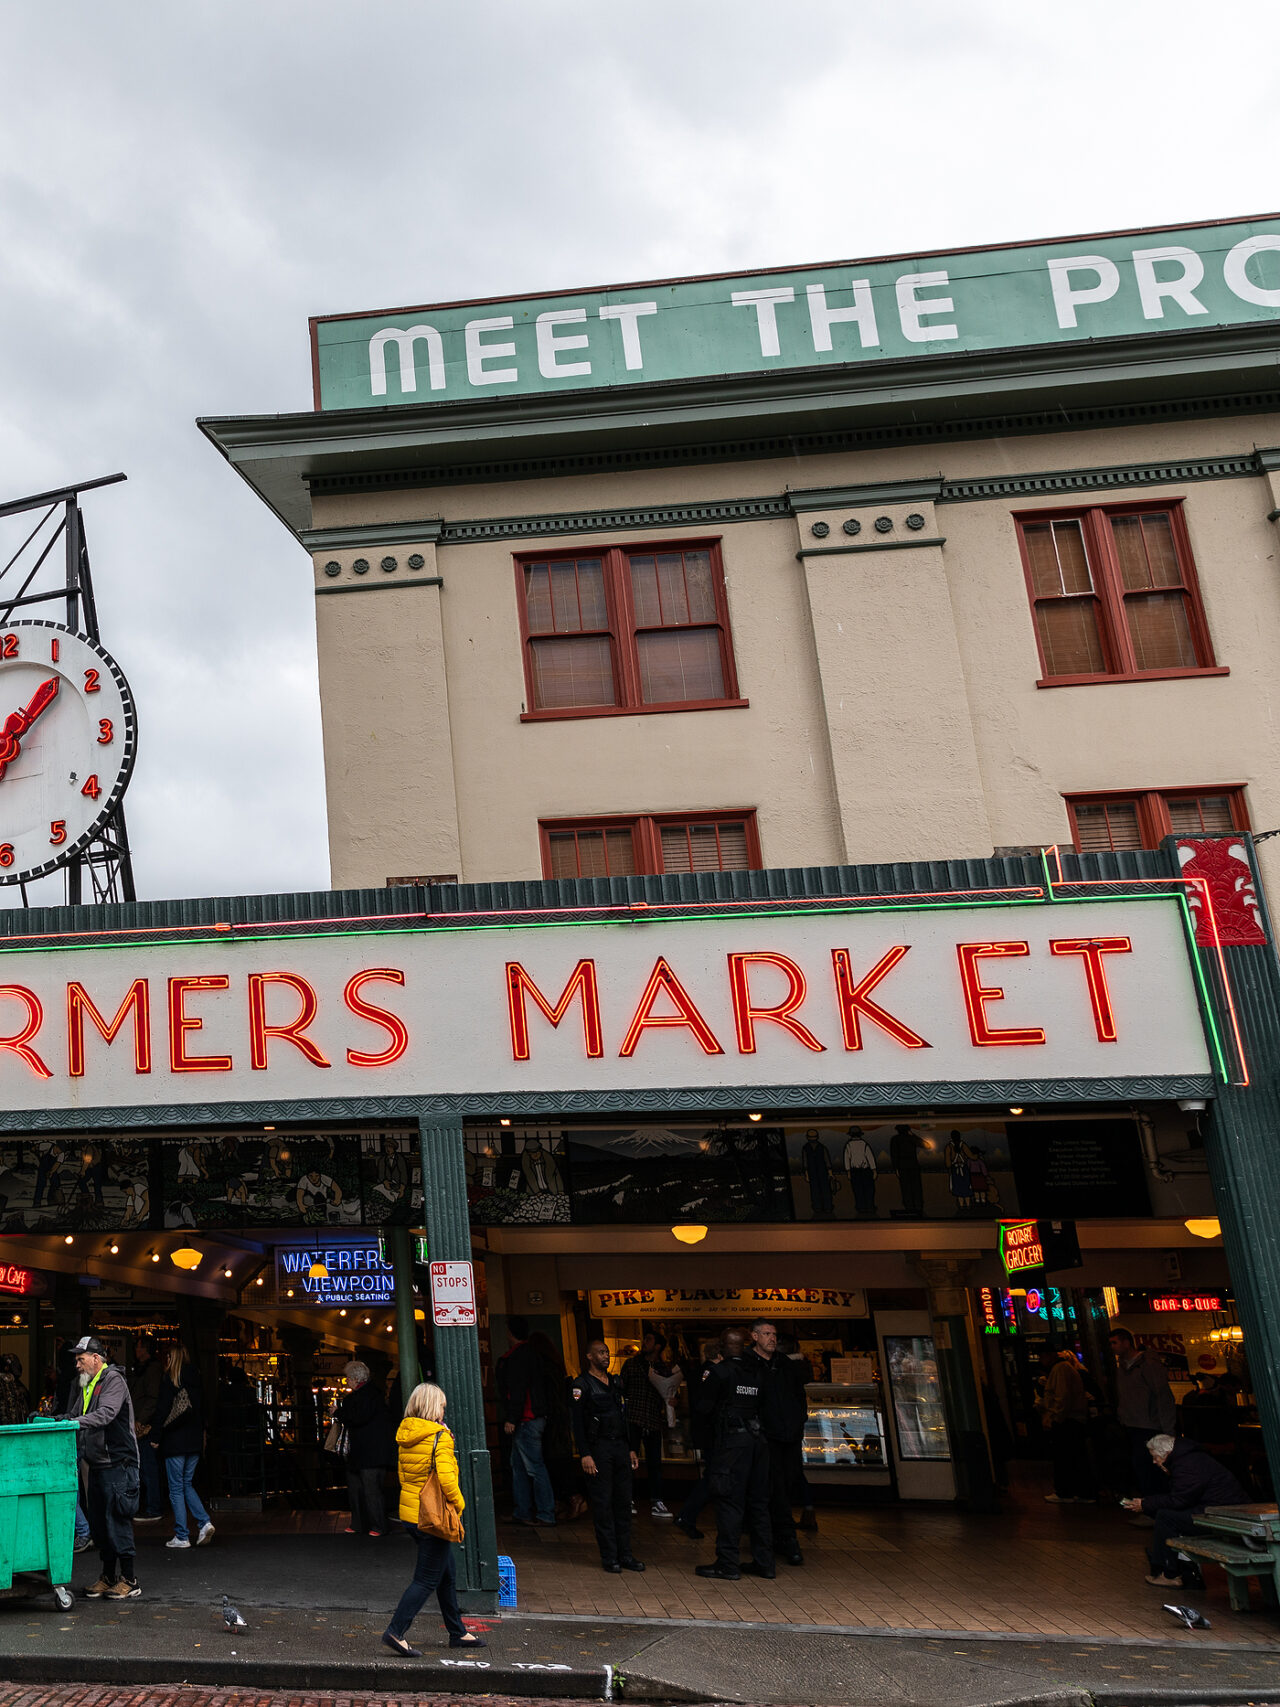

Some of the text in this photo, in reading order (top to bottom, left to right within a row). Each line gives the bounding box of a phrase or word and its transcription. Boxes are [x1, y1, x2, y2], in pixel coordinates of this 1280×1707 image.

[368, 234, 1280, 396] MEET THE PRO
[51, 638, 60, 662] 1
[83, 668, 101, 693] 2
[96, 718, 113, 744] 3
[81, 774, 102, 800] 4
[49, 820, 67, 844] 5
[505, 935, 1132, 1061] MARKET
[1006, 1225, 1033, 1246] ROTARY
[1006, 1244, 1044, 1269] GROCERY
[432, 1264, 445, 1274] NO
[437, 1276, 468, 1288] STOPS
[325, 1294, 353, 1302] PUBLIC
[355, 1293, 390, 1301] SEATING
[598, 1288, 856, 1308] PIKE PLACE BAKERY
[1153, 1298, 1219, 1311] BAR-B-QUE
[985, 1326, 1000, 1334] ATM
[736, 1384, 759, 1396] SECURITY
